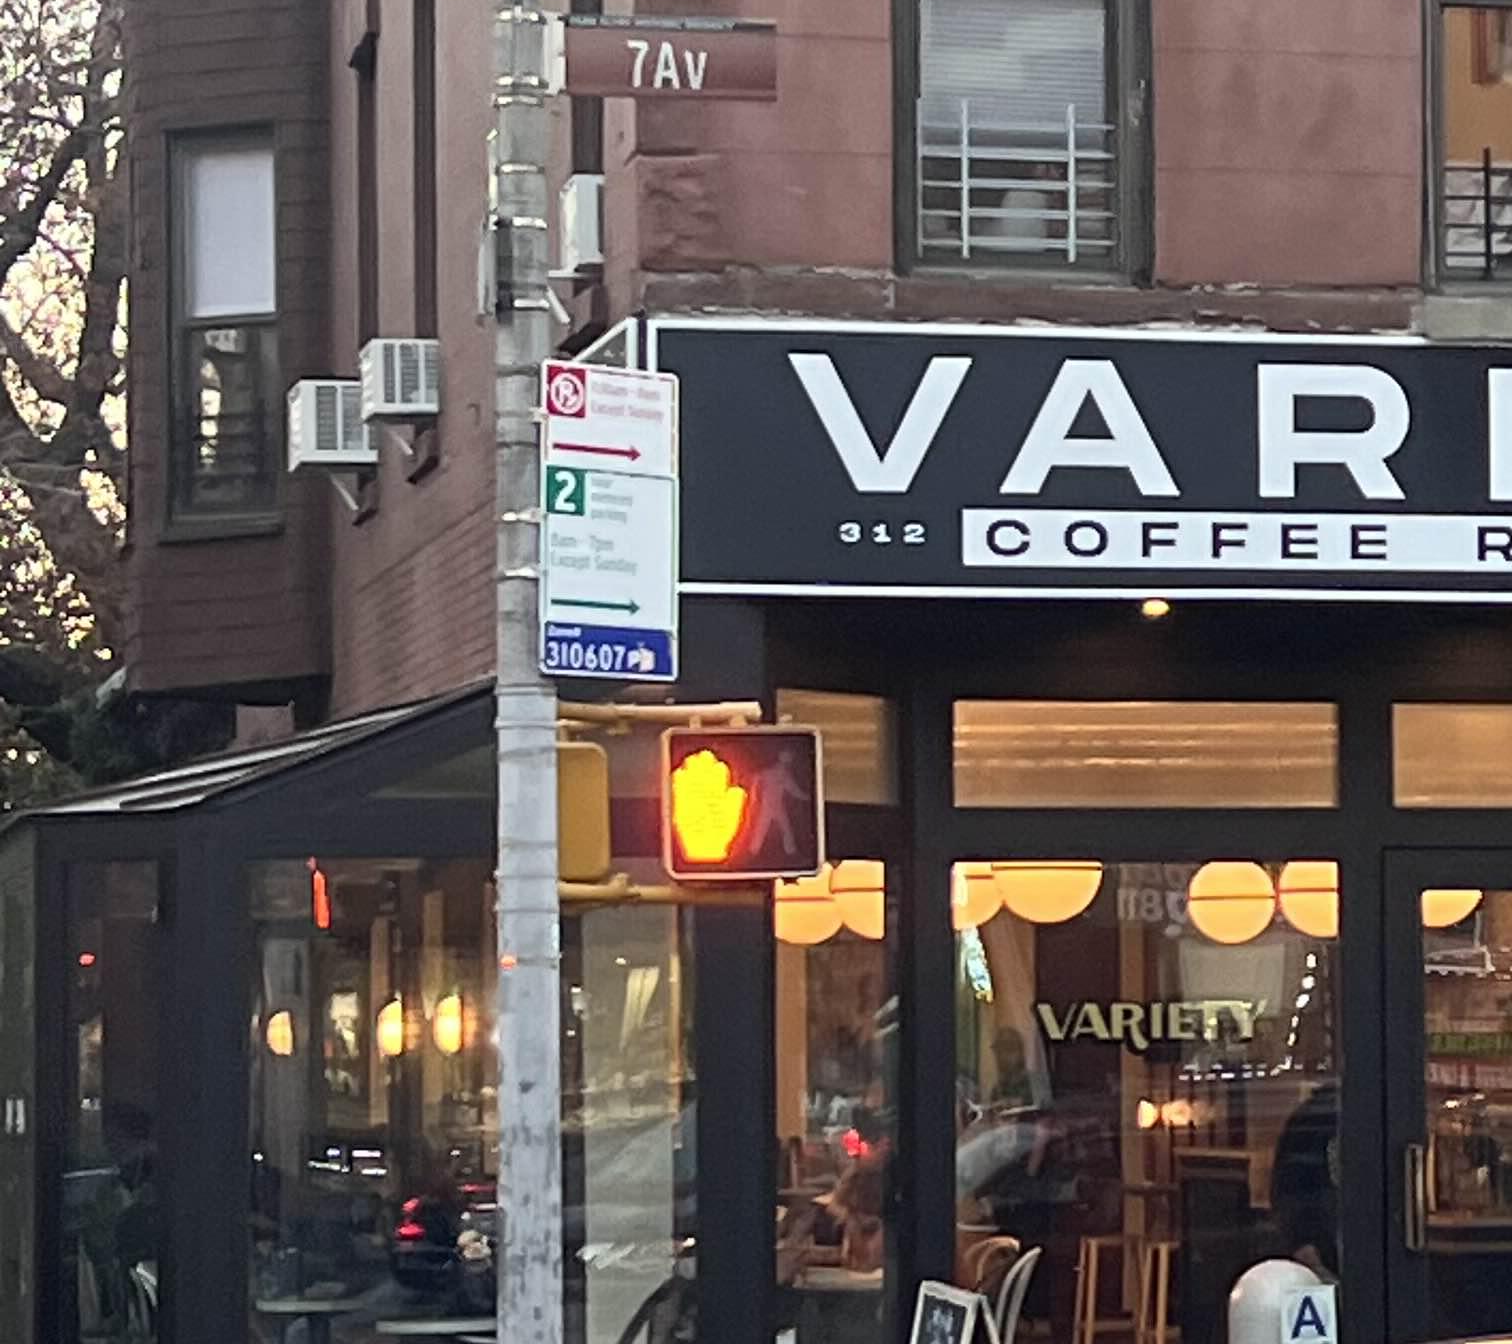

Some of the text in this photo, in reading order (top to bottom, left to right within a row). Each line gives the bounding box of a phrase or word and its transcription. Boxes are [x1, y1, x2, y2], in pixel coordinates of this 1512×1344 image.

[554, 470, 577, 513] 2
[839, 520, 928, 545] 312
[985, 518, 1389, 560] COFFEE
[546, 641, 626, 671] 310607
[1037, 997, 1266, 1051] VARIETY
[1290, 1294, 1328, 1340] A
